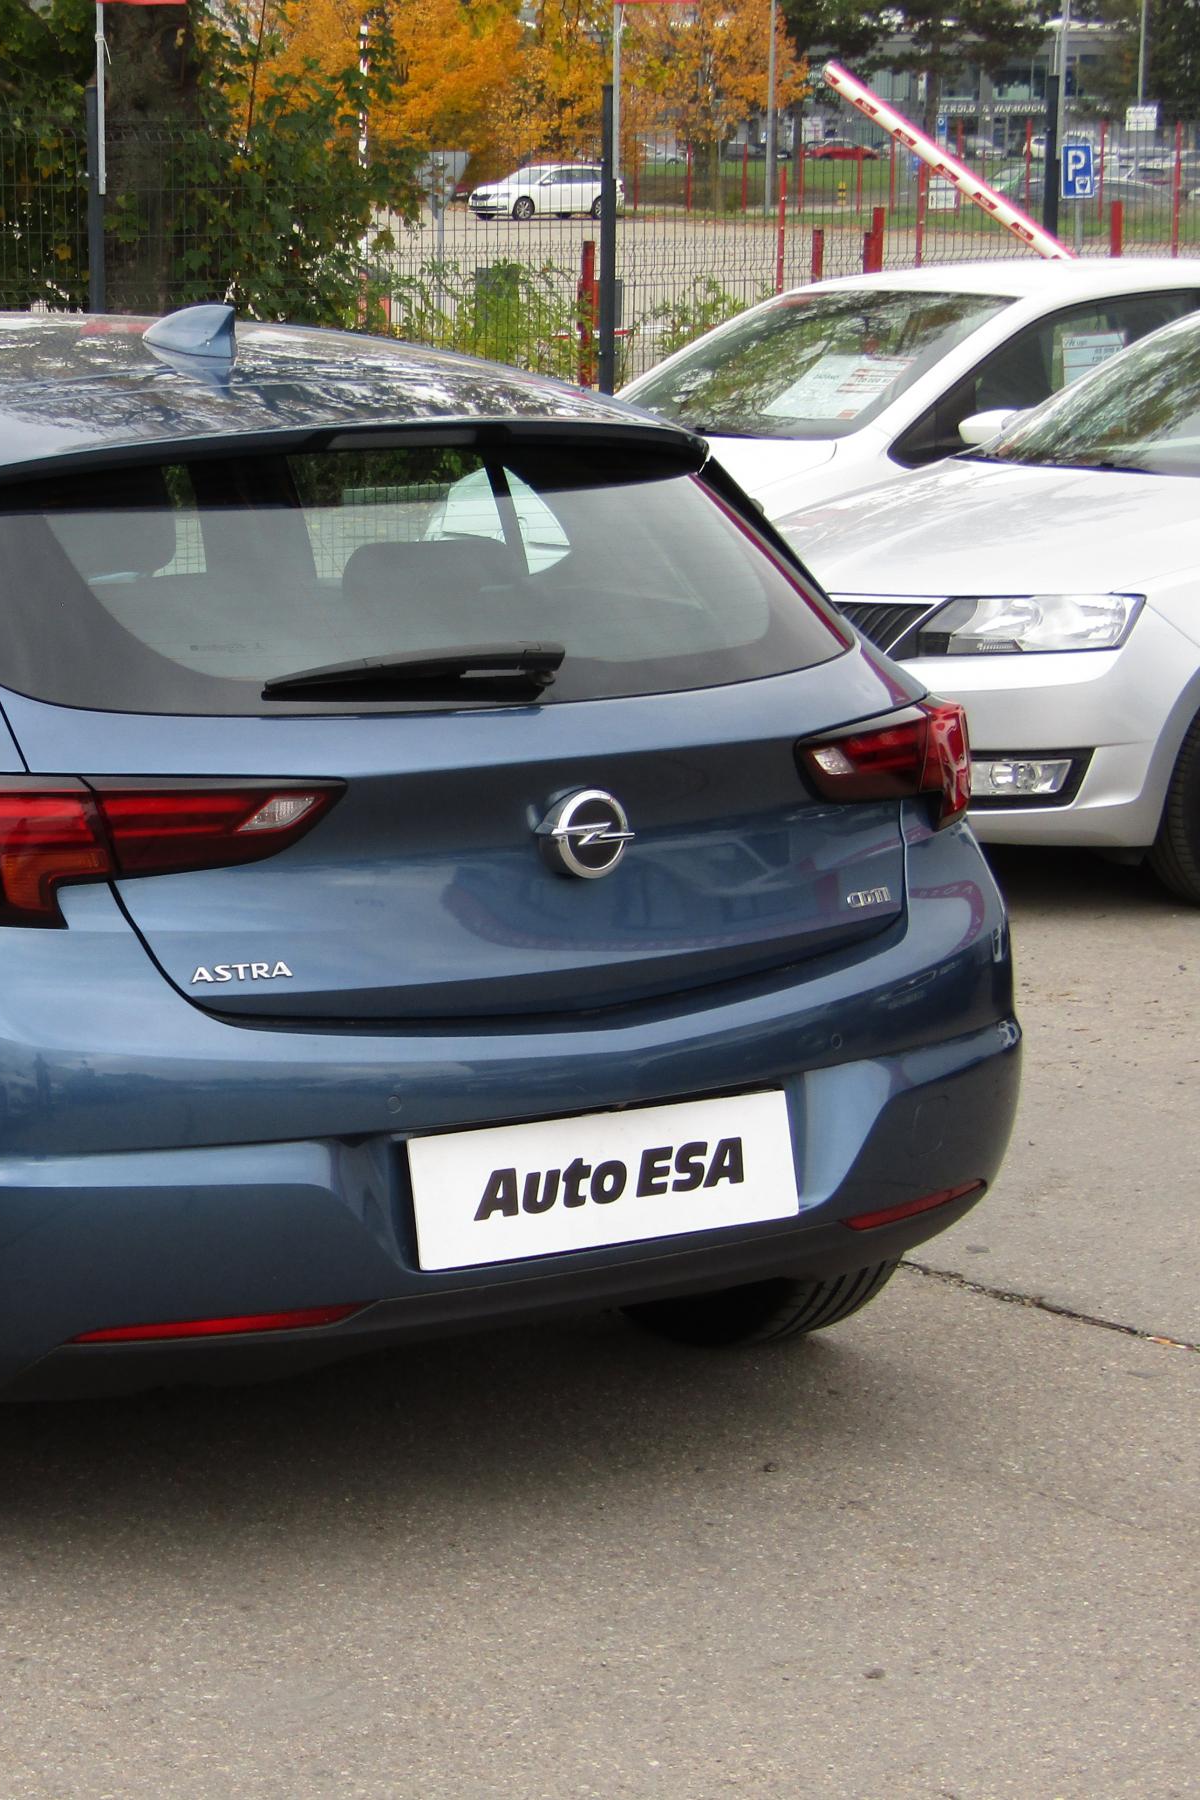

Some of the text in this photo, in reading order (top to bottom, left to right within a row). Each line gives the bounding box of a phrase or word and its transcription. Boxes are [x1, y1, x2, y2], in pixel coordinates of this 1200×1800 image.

[1067, 149, 1086, 182] P
[846, 886, 892, 909] CDTI
[190, 961, 294, 984] ASTRA
[473, 1136, 745, 1221] Auto ESA
